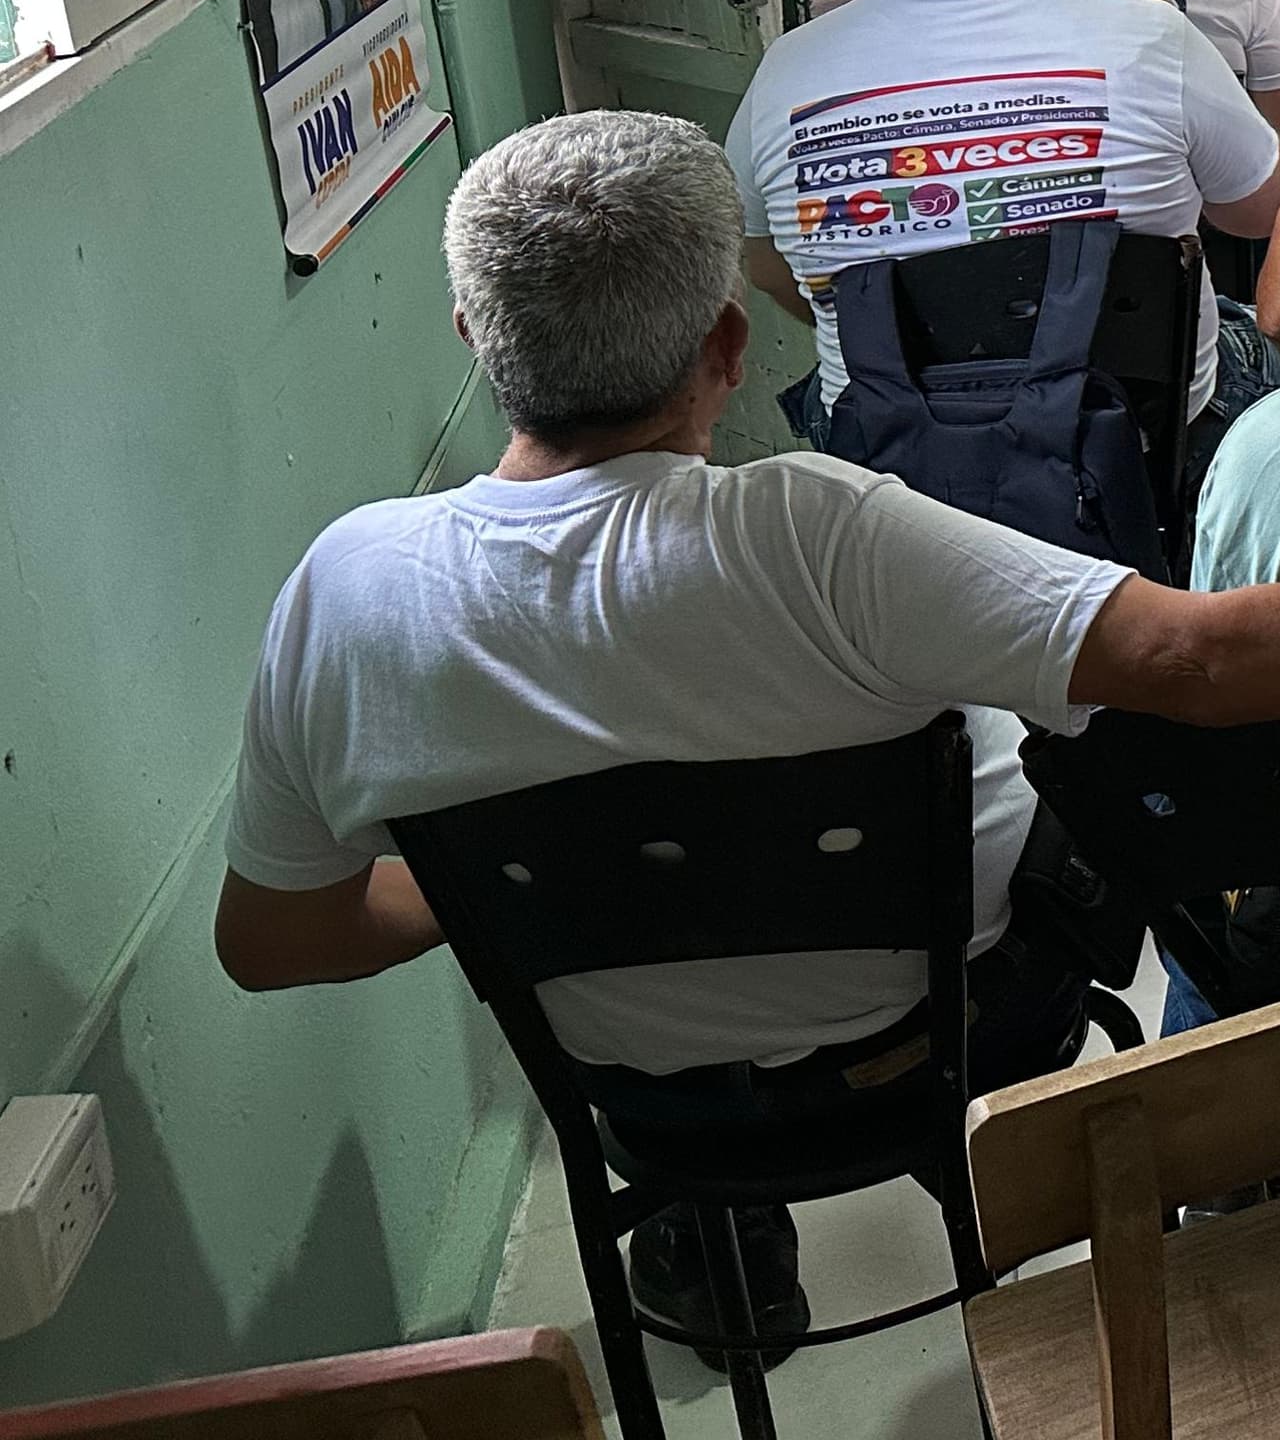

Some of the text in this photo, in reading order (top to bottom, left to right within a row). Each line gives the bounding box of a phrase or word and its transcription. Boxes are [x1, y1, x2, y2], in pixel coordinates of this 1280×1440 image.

[369, 35, 421, 129] AIDA
[795, 94, 1071, 140] El cambio no se vota a medias.
[828, 135, 861, 146] veces
[862, 130, 900, 142] Pacto:
[903, 122, 957, 136] Cámara,
[959, 116, 1008, 129] Senado
[1010, 116, 1019, 124] y
[1021, 109, 1099, 122] Presidencia.
[803, 134, 1089, 186] Vota 3 veces
[1002, 172, 1093, 193] Cámara
[796, 183, 960, 233] PACTO
[1007, 196, 1092, 218] Senado
[802, 219, 952, 242] HISTÓRICO
